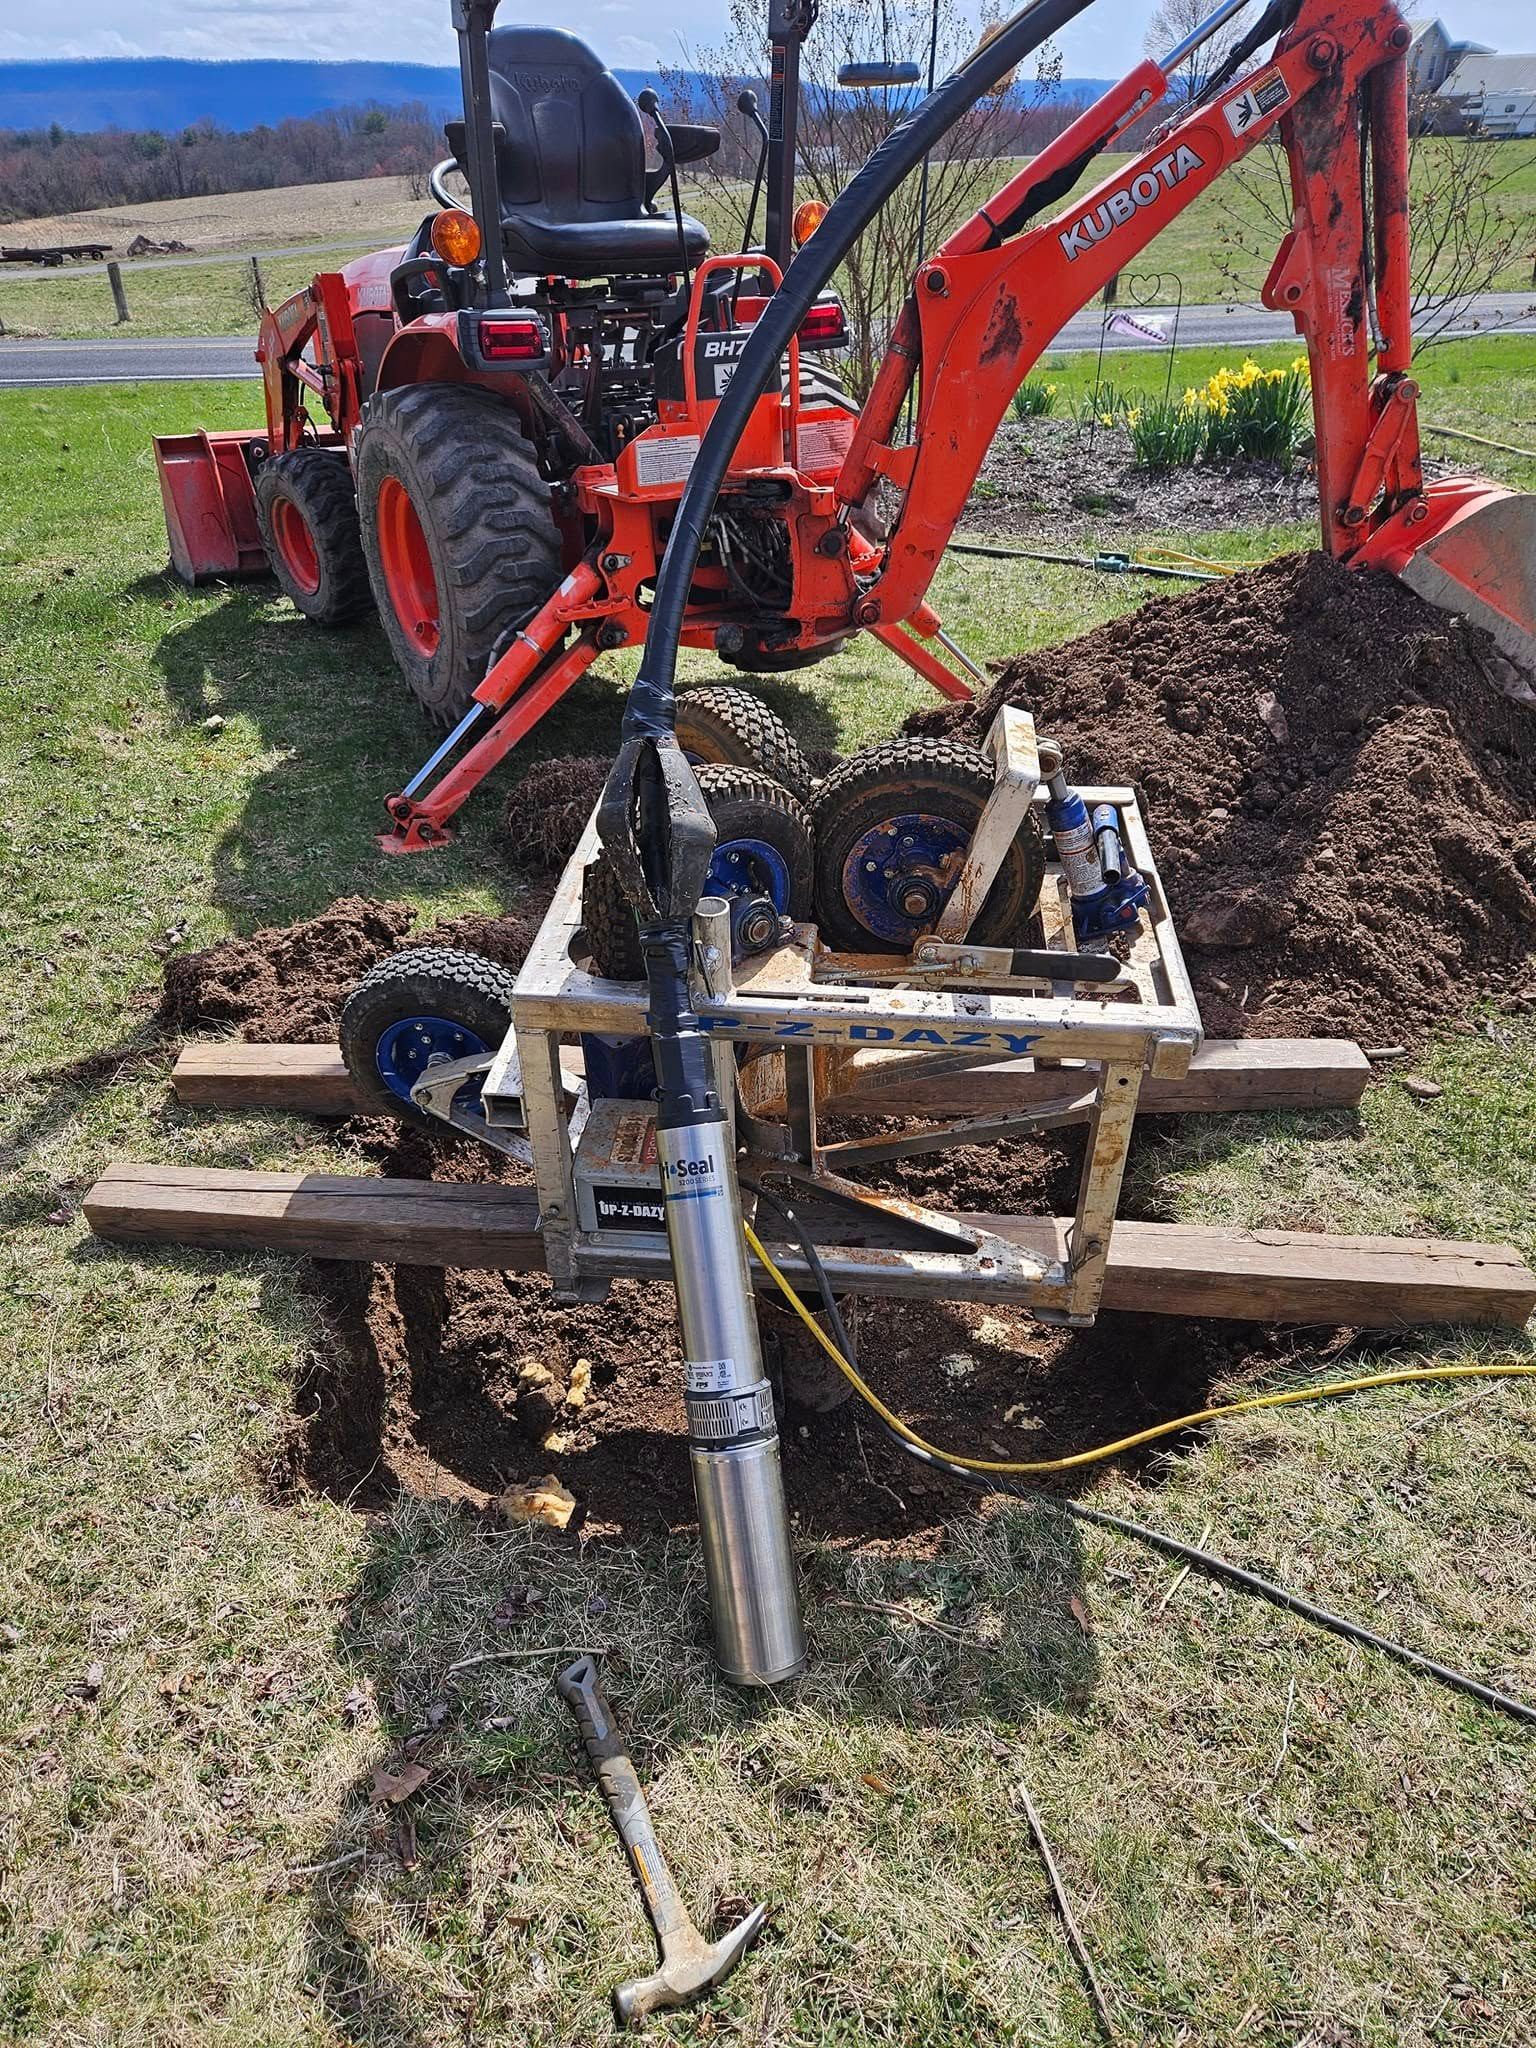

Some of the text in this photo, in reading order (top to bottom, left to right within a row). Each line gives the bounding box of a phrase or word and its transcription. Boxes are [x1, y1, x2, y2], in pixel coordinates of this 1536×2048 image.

[1058, 143, 1205, 263] KUBOTA
[640, 1012, 1045, 1054] P-Z-DAZY
[677, 1154, 714, 1177] Seal
[598, 1200, 665, 1221] UP-Z-DAZY
